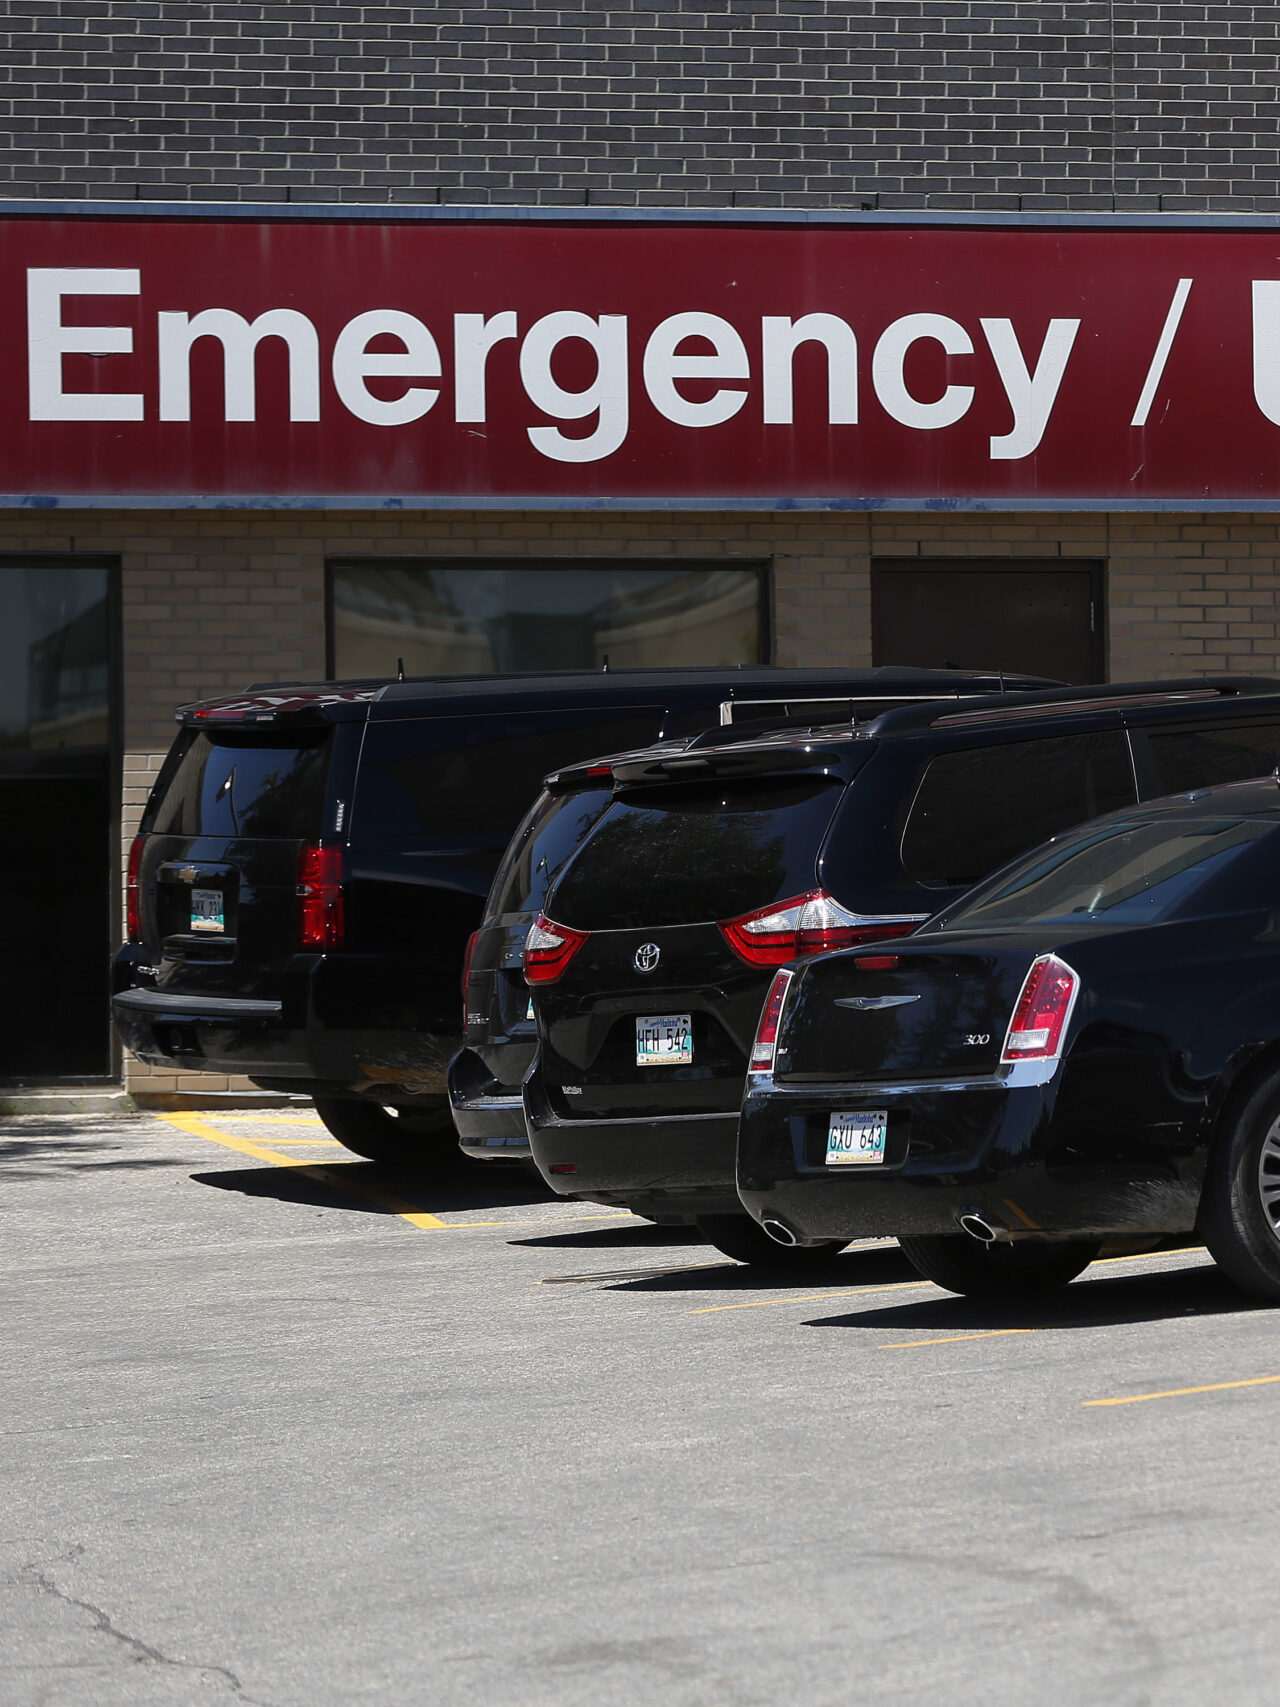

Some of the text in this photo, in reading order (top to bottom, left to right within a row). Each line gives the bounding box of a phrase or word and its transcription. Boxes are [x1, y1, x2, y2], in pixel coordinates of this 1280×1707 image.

[27, 267, 1080, 463] Emergency
[1131, 278, 1193, 427] /
[638, 1028, 688, 1053] HFH 542
[963, 1034, 990, 1044] 300
[830, 1124, 882, 1150] GXU 643
